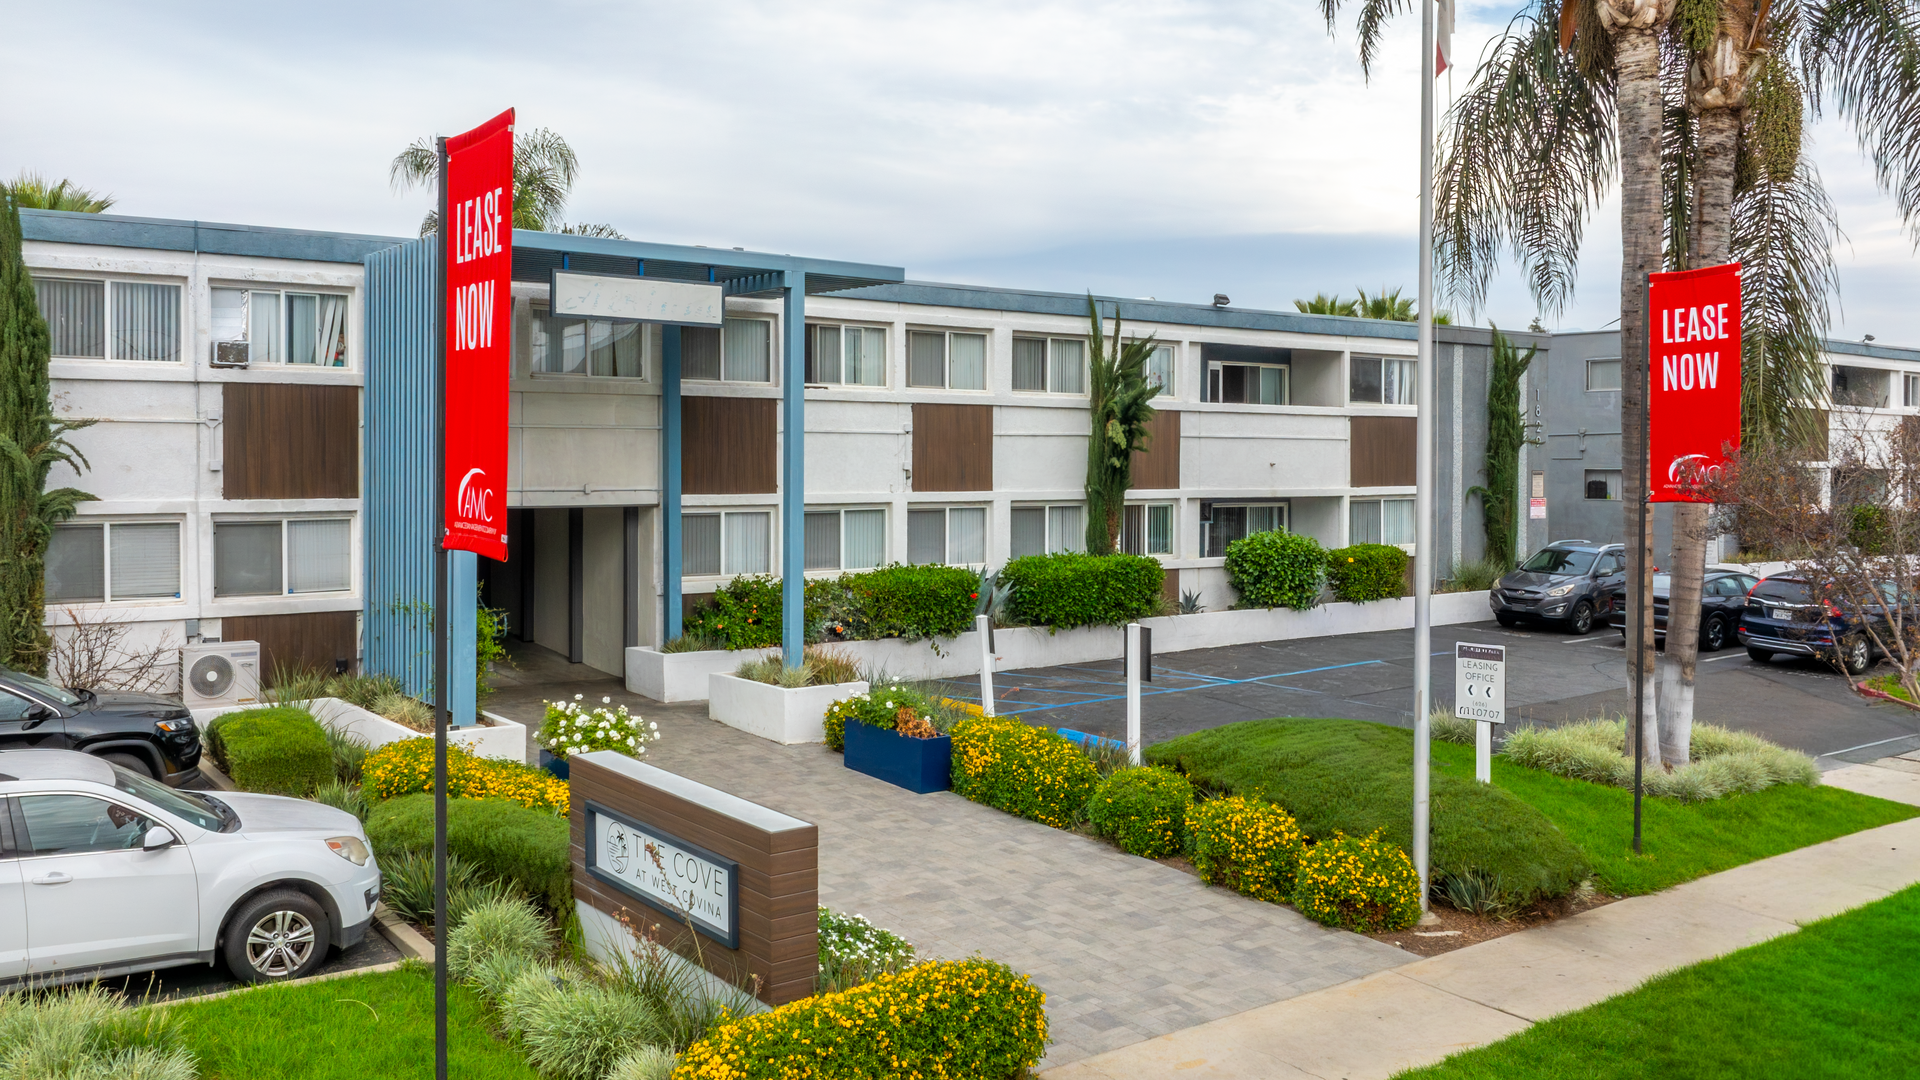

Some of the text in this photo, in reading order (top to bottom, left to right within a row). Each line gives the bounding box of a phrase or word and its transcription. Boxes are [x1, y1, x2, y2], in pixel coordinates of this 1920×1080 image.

[457, 187, 502, 264] LEASE
[456, 279, 495, 351] NOW
[1662, 303, 1729, 344] LEASE
[1662, 351, 1719, 391] NOW
[463, 486, 493, 522] AMC
[1462, 661, 1498, 671] LEASING
[1465, 672, 1495, 683] OFFICE
[632, 833, 723, 898] THE COVE
[635, 868, 722, 921] AT WEST COVINA
